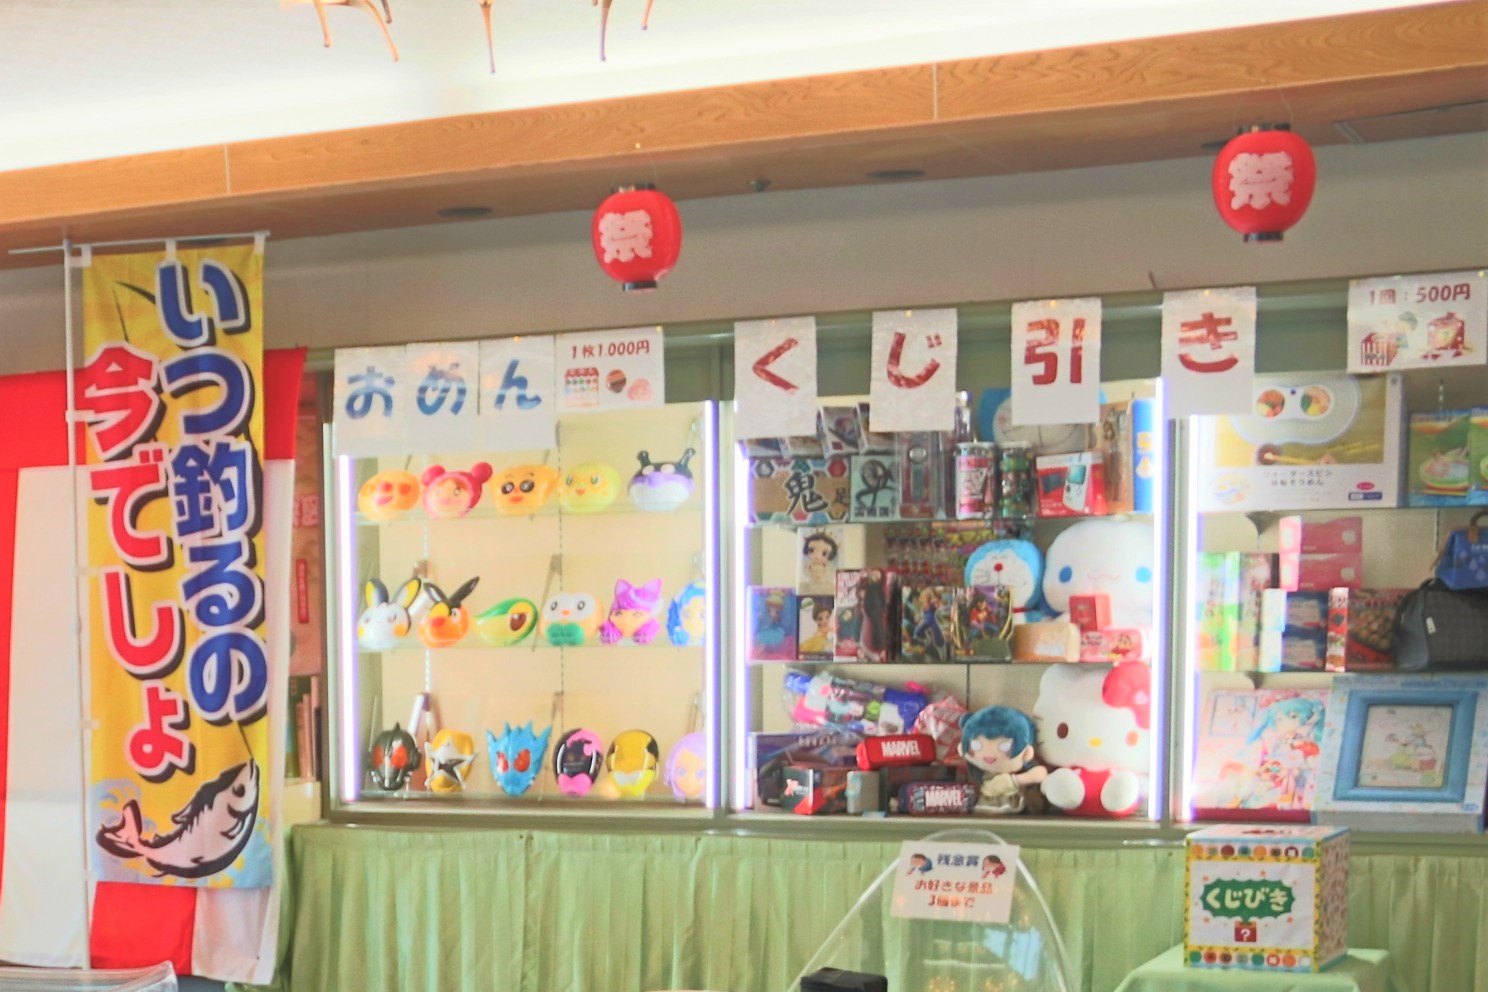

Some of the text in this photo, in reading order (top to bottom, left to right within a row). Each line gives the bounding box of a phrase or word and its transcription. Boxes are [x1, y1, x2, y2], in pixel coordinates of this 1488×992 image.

[1226, 150, 1295, 210] 祭
[600, 209, 654, 263] 祭
[344, 359, 543, 420] おめん
[154, 259, 268, 721] いつ釣るの
[86, 341, 198, 779] 今でしょ
[881, 740, 921, 757] MARVEL
[925, 789, 963, 807] MARVEL
[1205, 886, 1290, 912] くじびき
